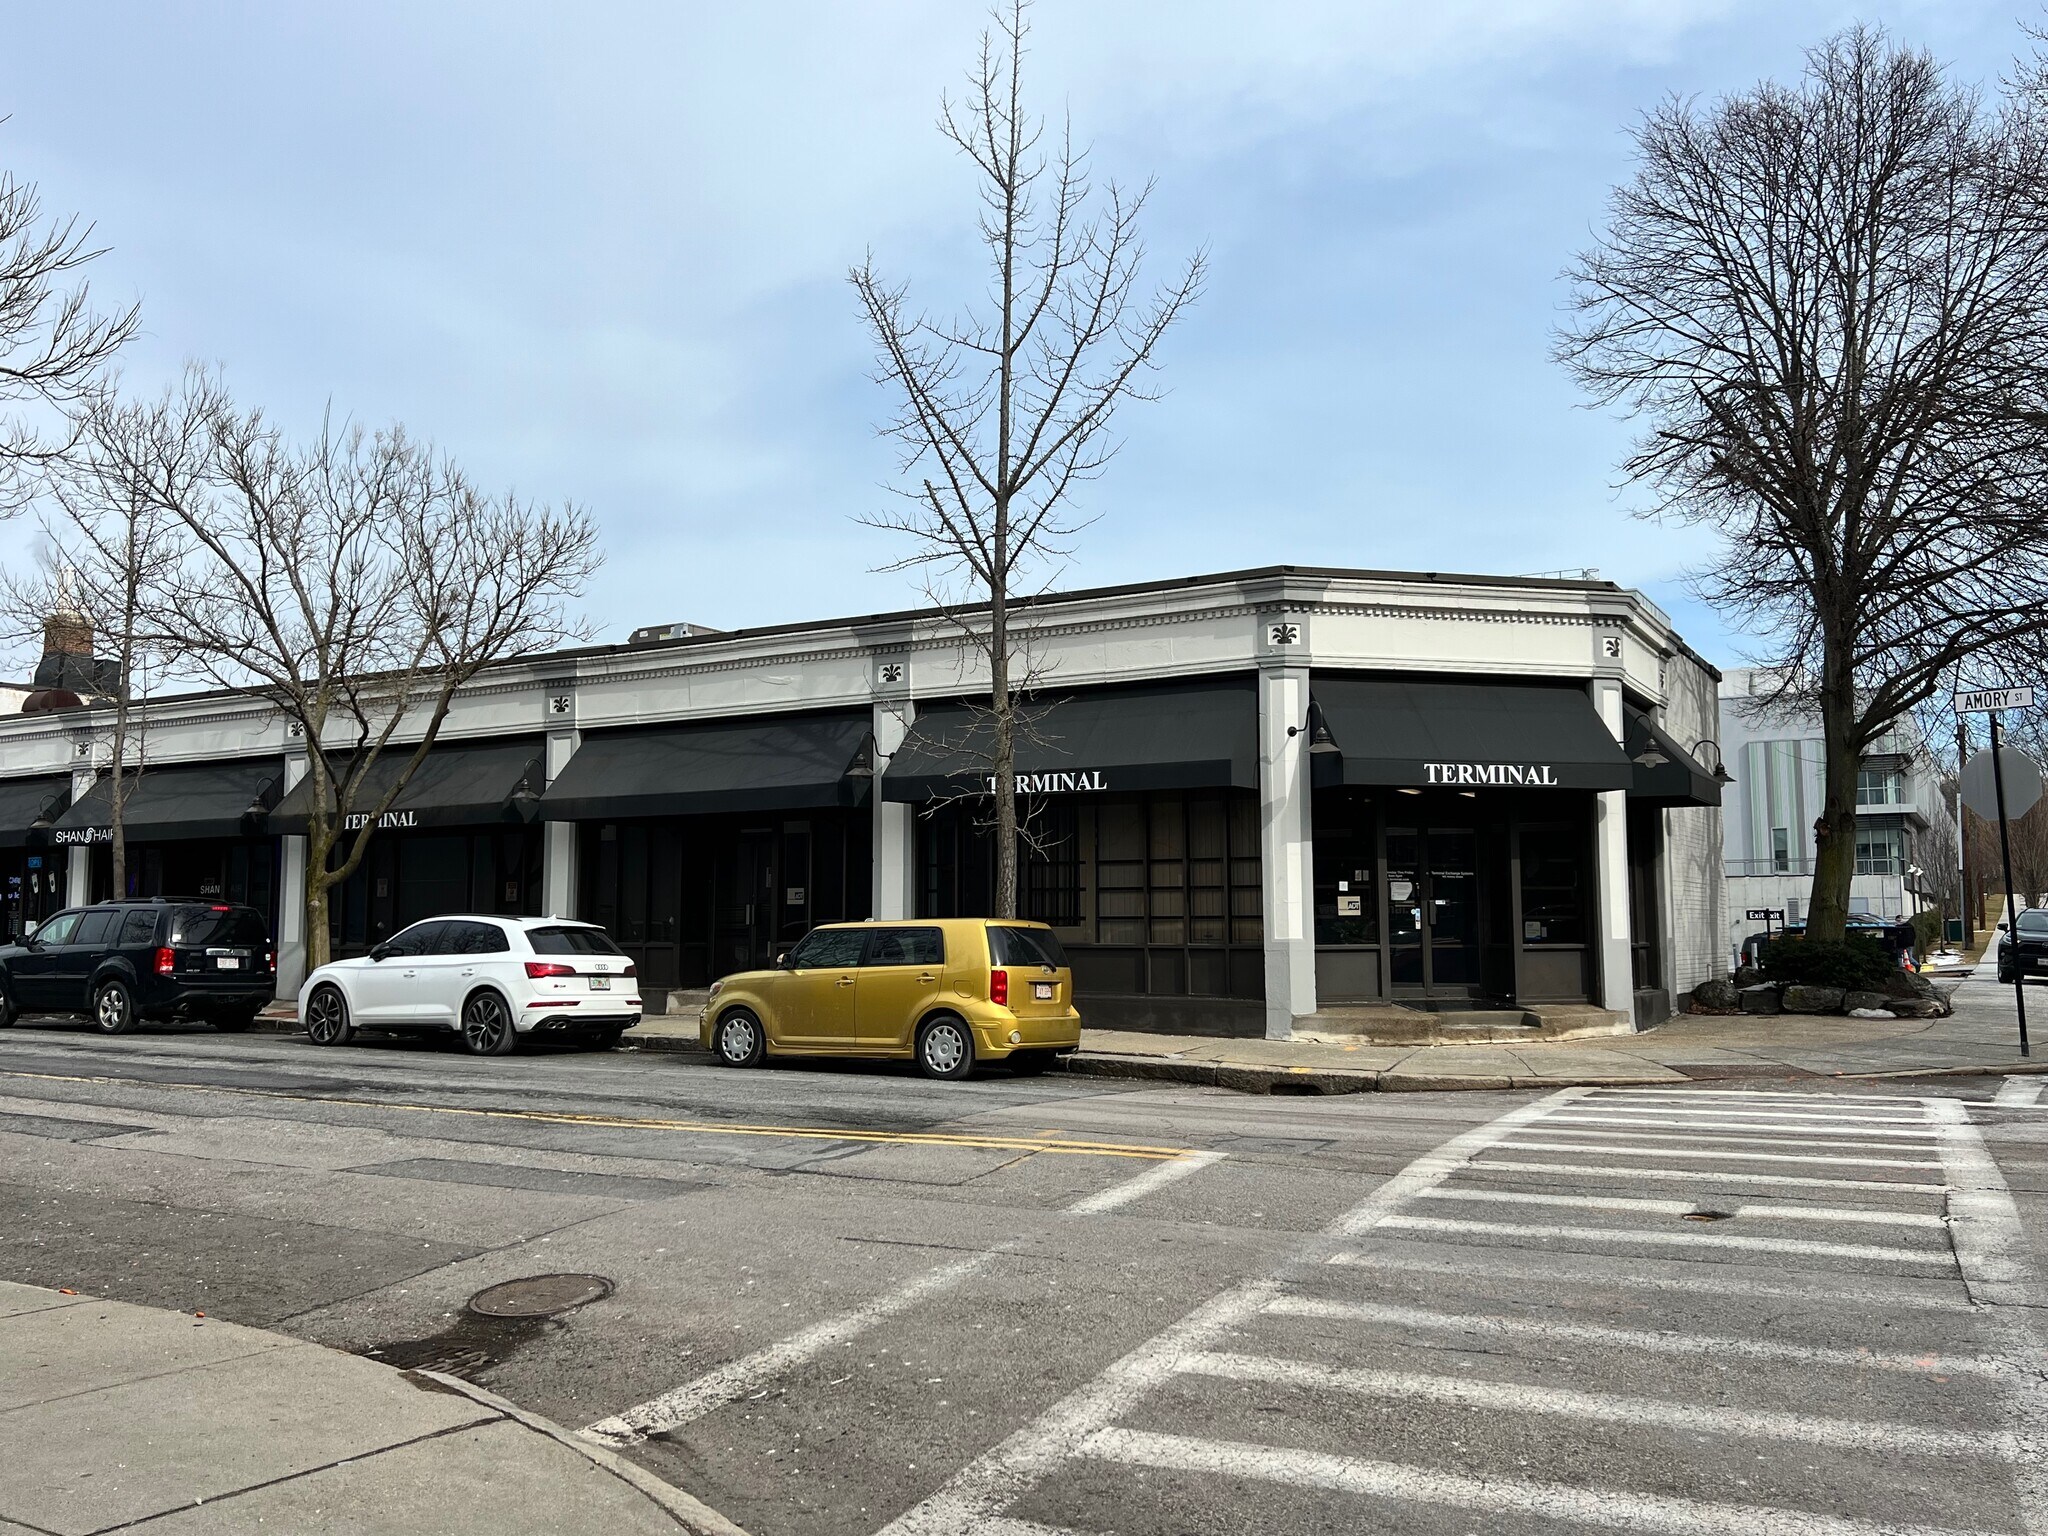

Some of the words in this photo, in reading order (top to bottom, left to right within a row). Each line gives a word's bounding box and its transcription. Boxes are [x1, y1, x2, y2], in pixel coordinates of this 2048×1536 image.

[1965, 691, 2010, 709] AMORY
[2014, 692, 2023, 701] ST
[1423, 763, 1558, 786] TERMINAL
[986, 771, 1108, 794] TRMINAL
[344, 811, 418, 830] TERINAL
[55, 830, 85, 844] SHAN
[200, 885, 220, 895] SHAN
[1348, 902, 1359, 910] ADT
[1750, 911, 1765, 919] Exit
[1769, 911, 1780, 919] xit
